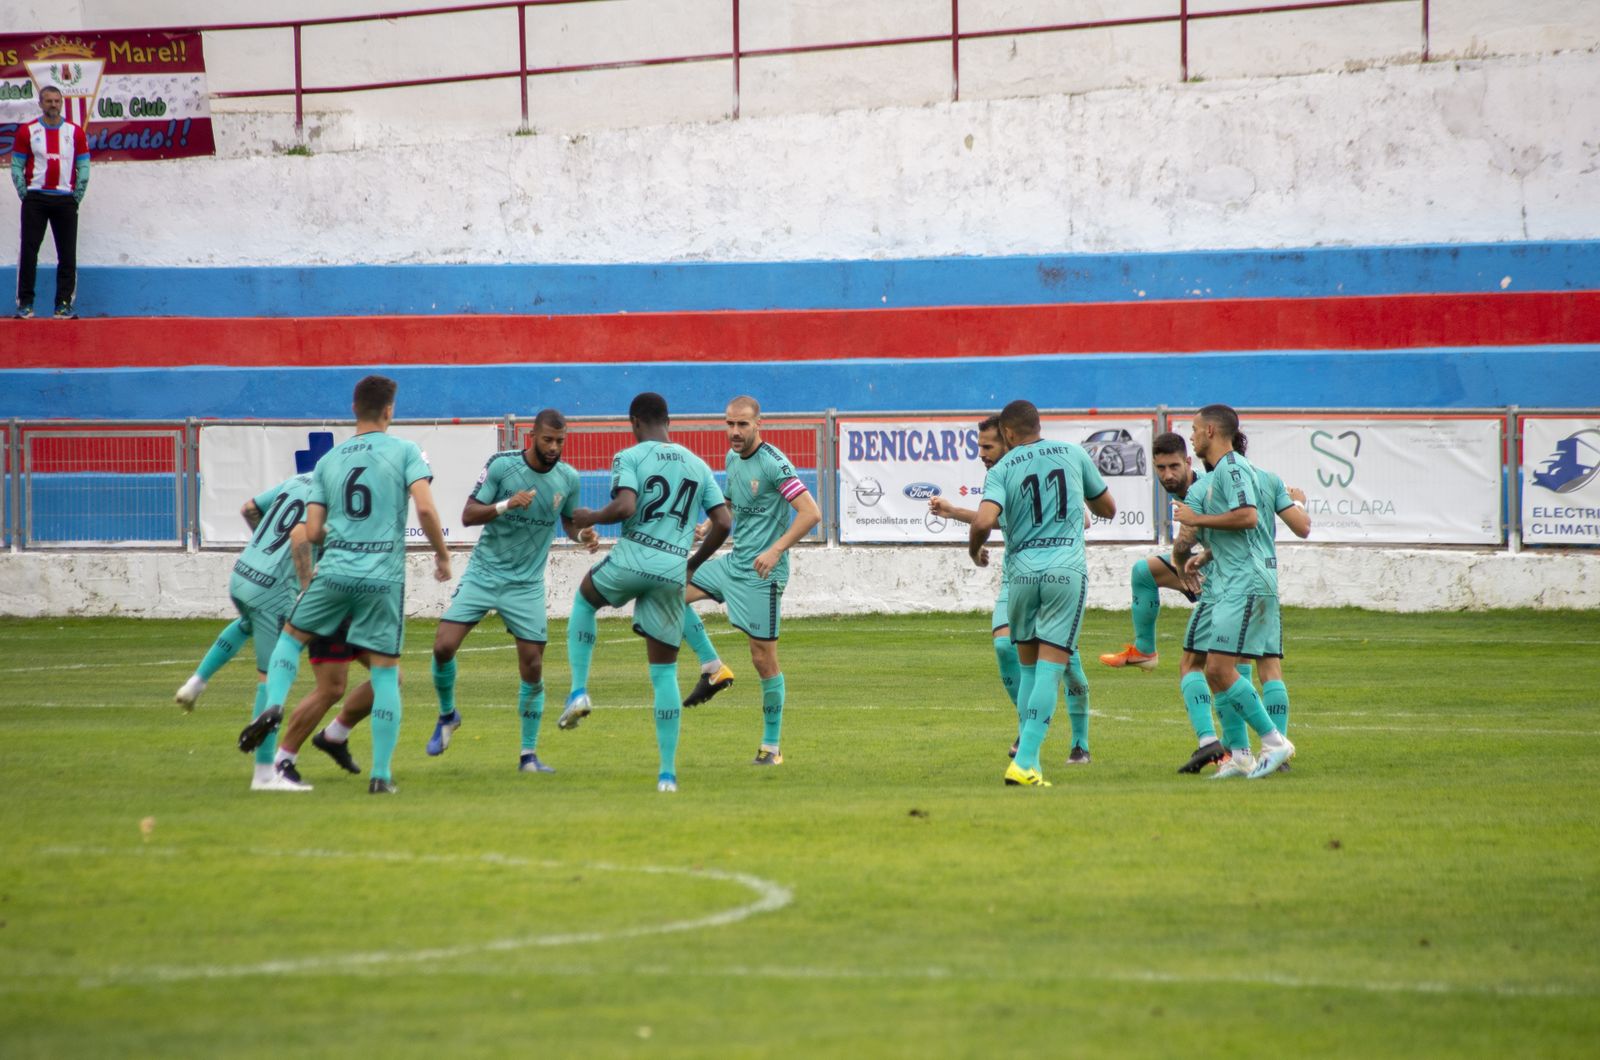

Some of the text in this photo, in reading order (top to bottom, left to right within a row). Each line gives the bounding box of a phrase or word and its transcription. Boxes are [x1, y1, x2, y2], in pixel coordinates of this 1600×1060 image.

[109, 40, 187, 64] Mare!!
[98, 96, 167, 118] Un Club
[341, 444, 374, 455] CERPA
[848, 429, 979, 461] BENICAR'S
[1005, 446, 1069, 468] PABLO GANET
[342, 466, 372, 521] 6
[909, 485, 935, 498] Ford
[1021, 468, 1067, 528] 11
[639, 474, 699, 533] 24
[1337, 499, 1397, 515] CLARA
[1533, 507, 1600, 519] ELECTRI
[253, 491, 305, 555] 19
[856, 517, 908, 526] especialistas
[1119, 511, 1145, 525] 300
[1532, 523, 1599, 536] CLIMATI
